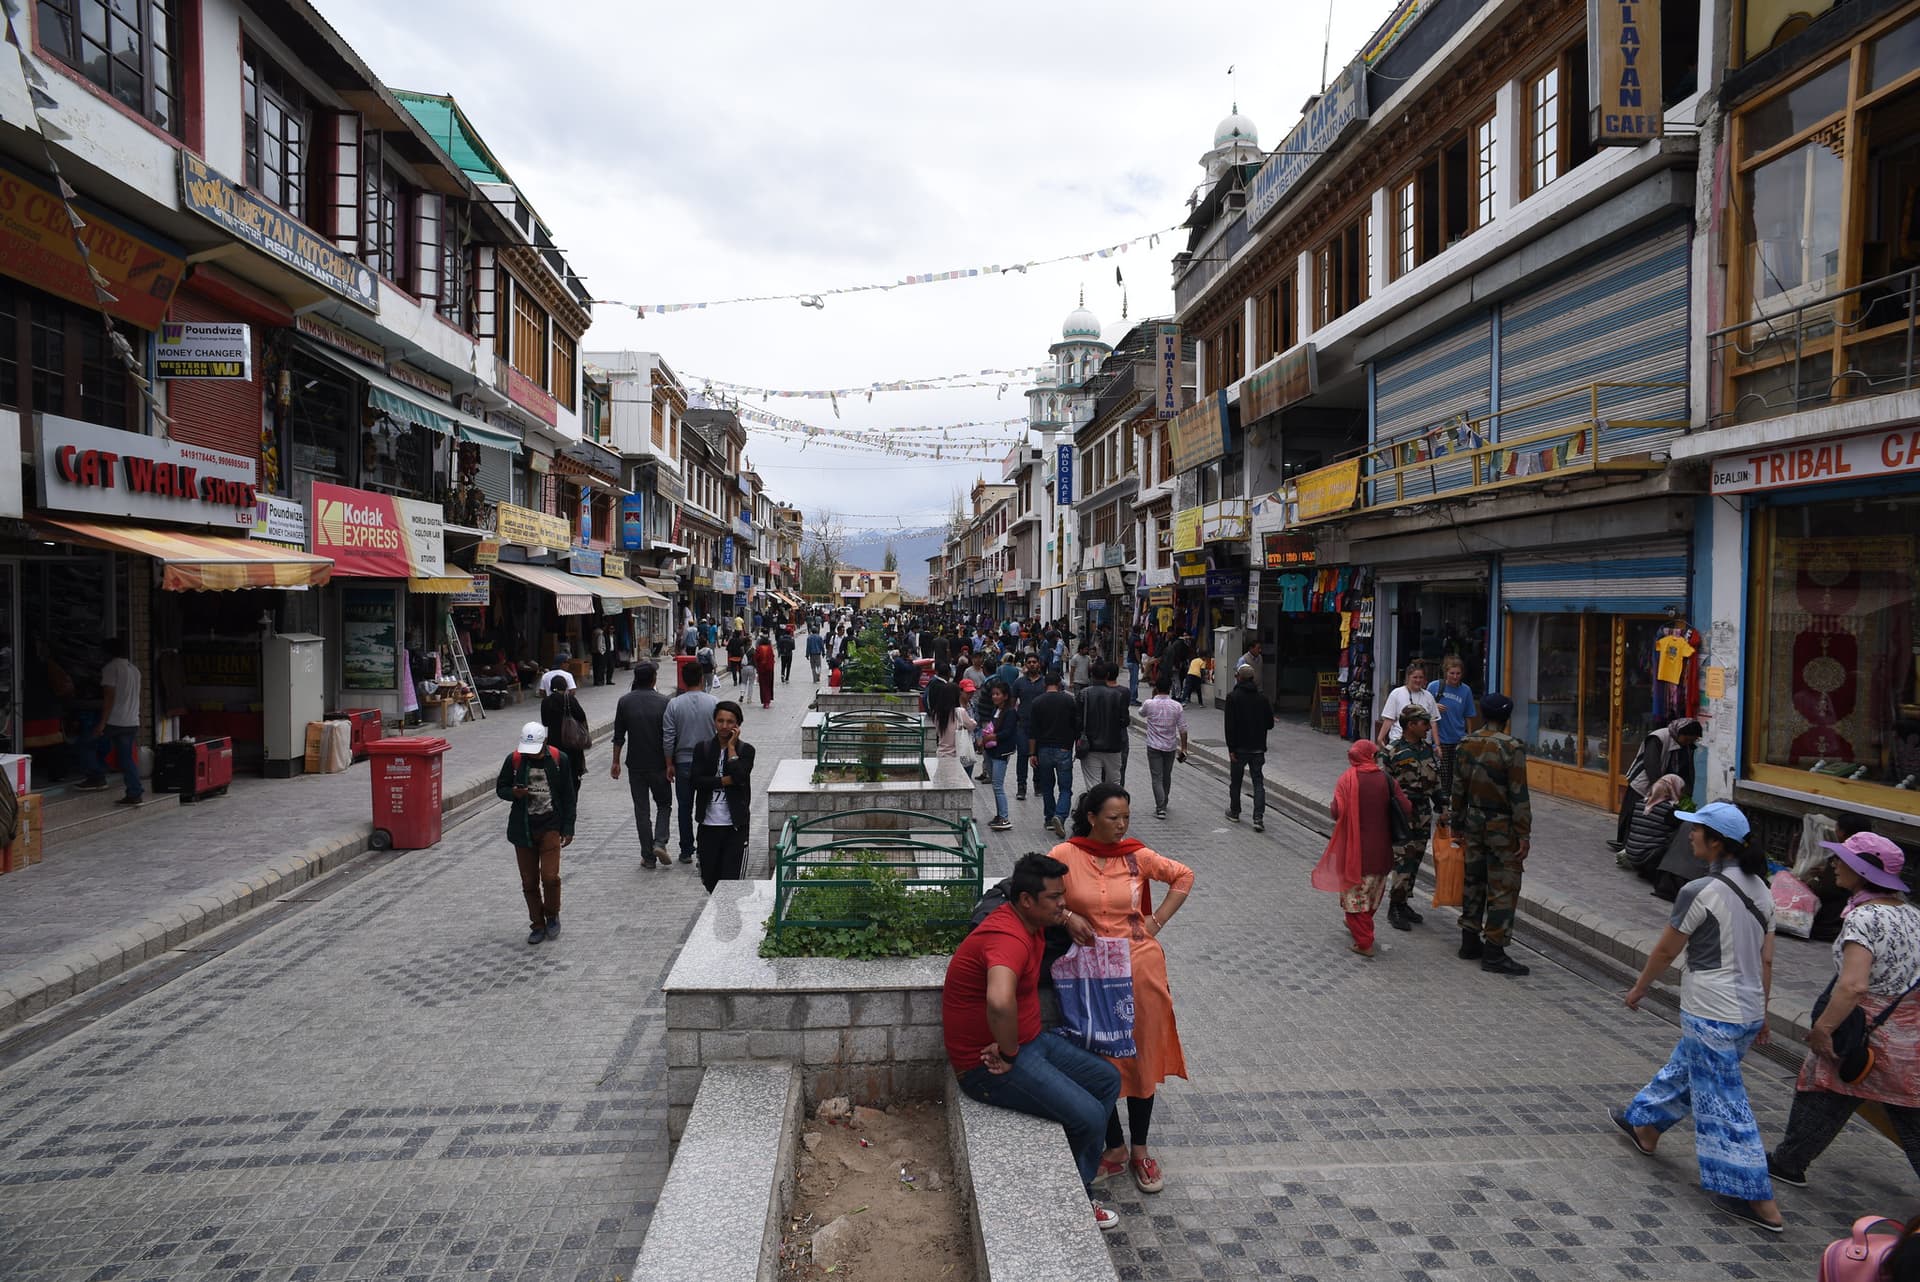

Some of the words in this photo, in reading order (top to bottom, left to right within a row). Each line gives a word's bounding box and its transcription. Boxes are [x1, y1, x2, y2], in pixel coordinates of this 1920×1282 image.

[1618, 0, 1641, 107] LAYAN
[1605, 115, 1658, 133] CAFE
[1256, 122, 1308, 202] HIMALAYAN
[1276, 161, 1303, 197] TIBETAN
[1303, 101, 1356, 168] RESTAURANT
[222, 184, 295, 250] TIBETAN
[297, 231, 356, 287] KITCHEN
[264, 236, 335, 286] RESTAURANT
[185, 325, 242, 335] Poundwize
[158, 348, 193, 357] MONEY
[194, 349, 243, 358] CHANGER
[175, 368, 208, 376] UNION
[1061, 446, 1069, 473] AMDO
[1748, 444, 1851, 485] TRIBAL
[55, 445, 119, 489] CAT
[122, 455, 199, 501] WALK
[201, 477, 257, 508] SHOES
[1061, 477, 1069, 504] CAFE
[235, 512, 253, 525] LEH
[269, 503, 303, 522] Poundwize
[344, 503, 384, 527] Kodak
[268, 526, 284, 537] MONEY
[344, 524, 399, 550] EXPRESS
